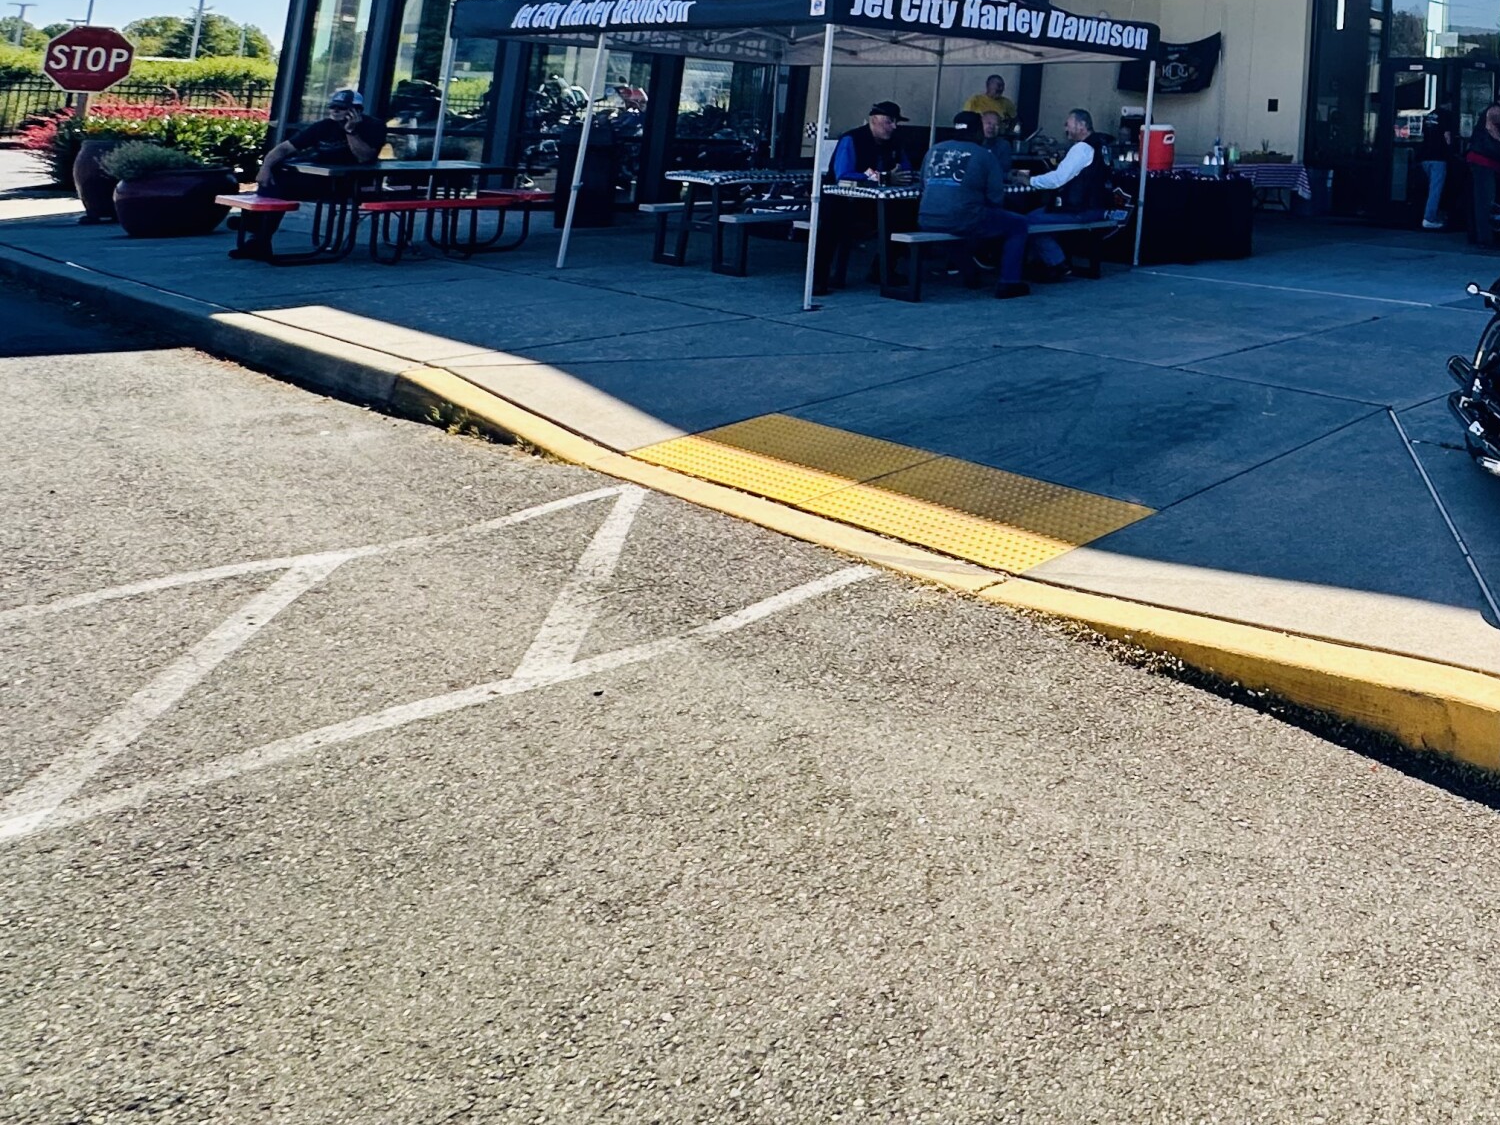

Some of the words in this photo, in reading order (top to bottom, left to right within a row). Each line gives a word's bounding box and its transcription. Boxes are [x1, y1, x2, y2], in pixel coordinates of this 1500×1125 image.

[533, 1, 566, 30] City
[1047, 9, 1149, 50] Davidson
[48, 44, 129, 72] STOP
